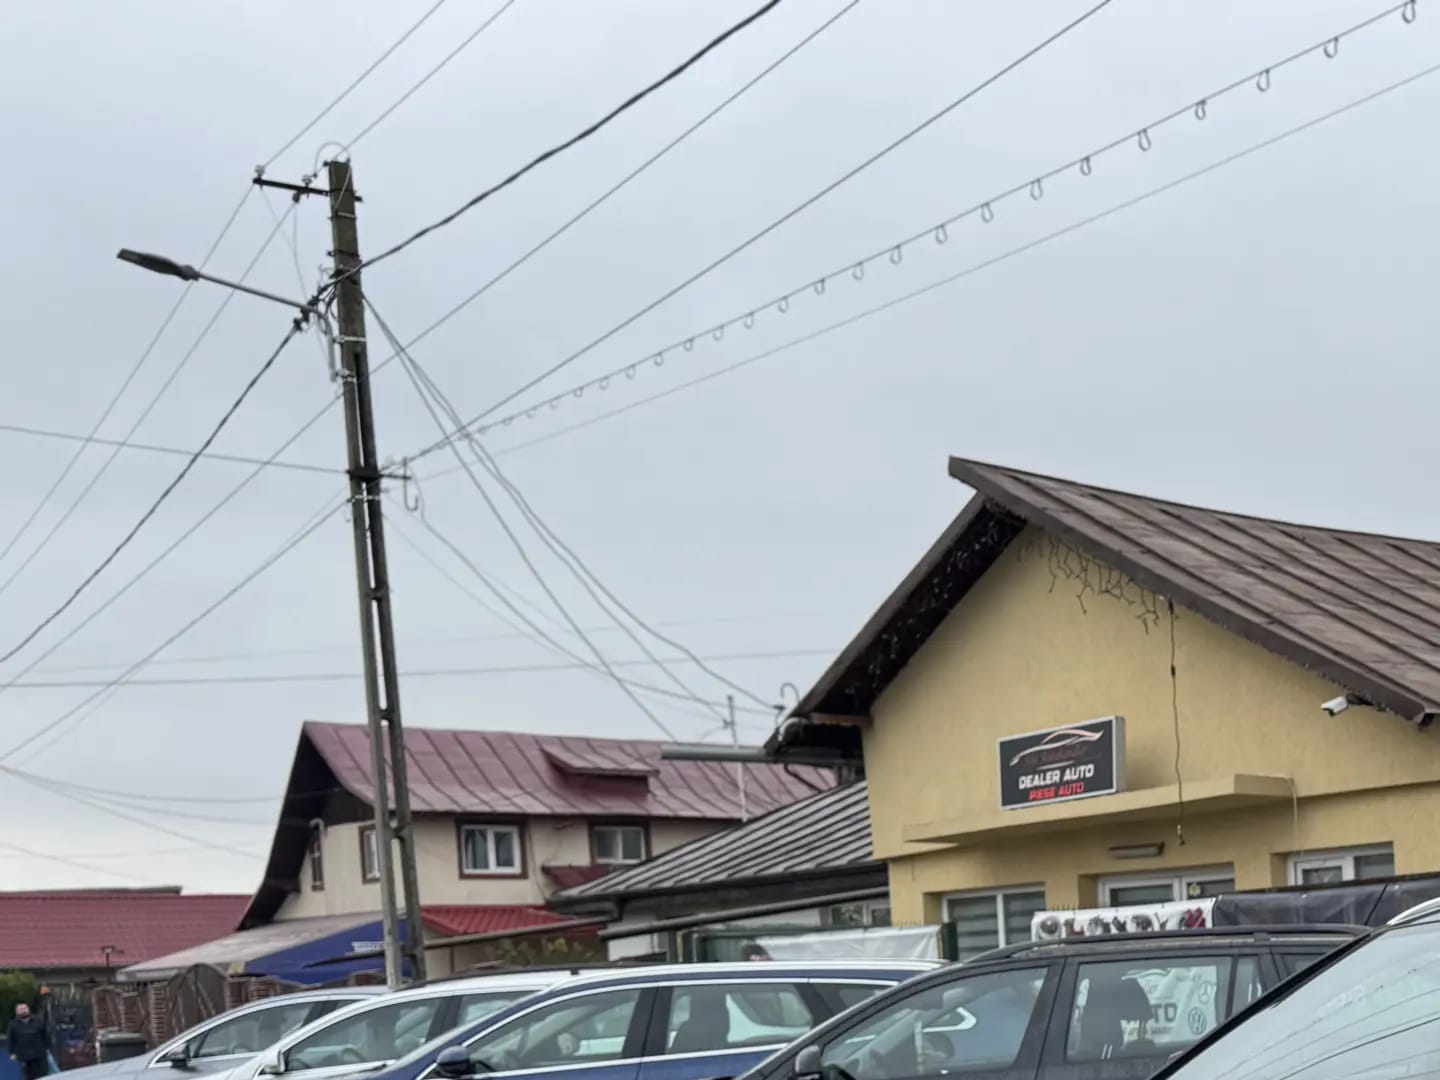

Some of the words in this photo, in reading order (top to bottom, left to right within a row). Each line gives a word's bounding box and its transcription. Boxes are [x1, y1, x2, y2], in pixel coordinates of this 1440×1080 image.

[1018, 769, 1060, 790] DEALER
[1063, 763, 1095, 782] AUTO
[1029, 786, 1056, 800] PIESE
[1058, 781, 1084, 796] AUTO
